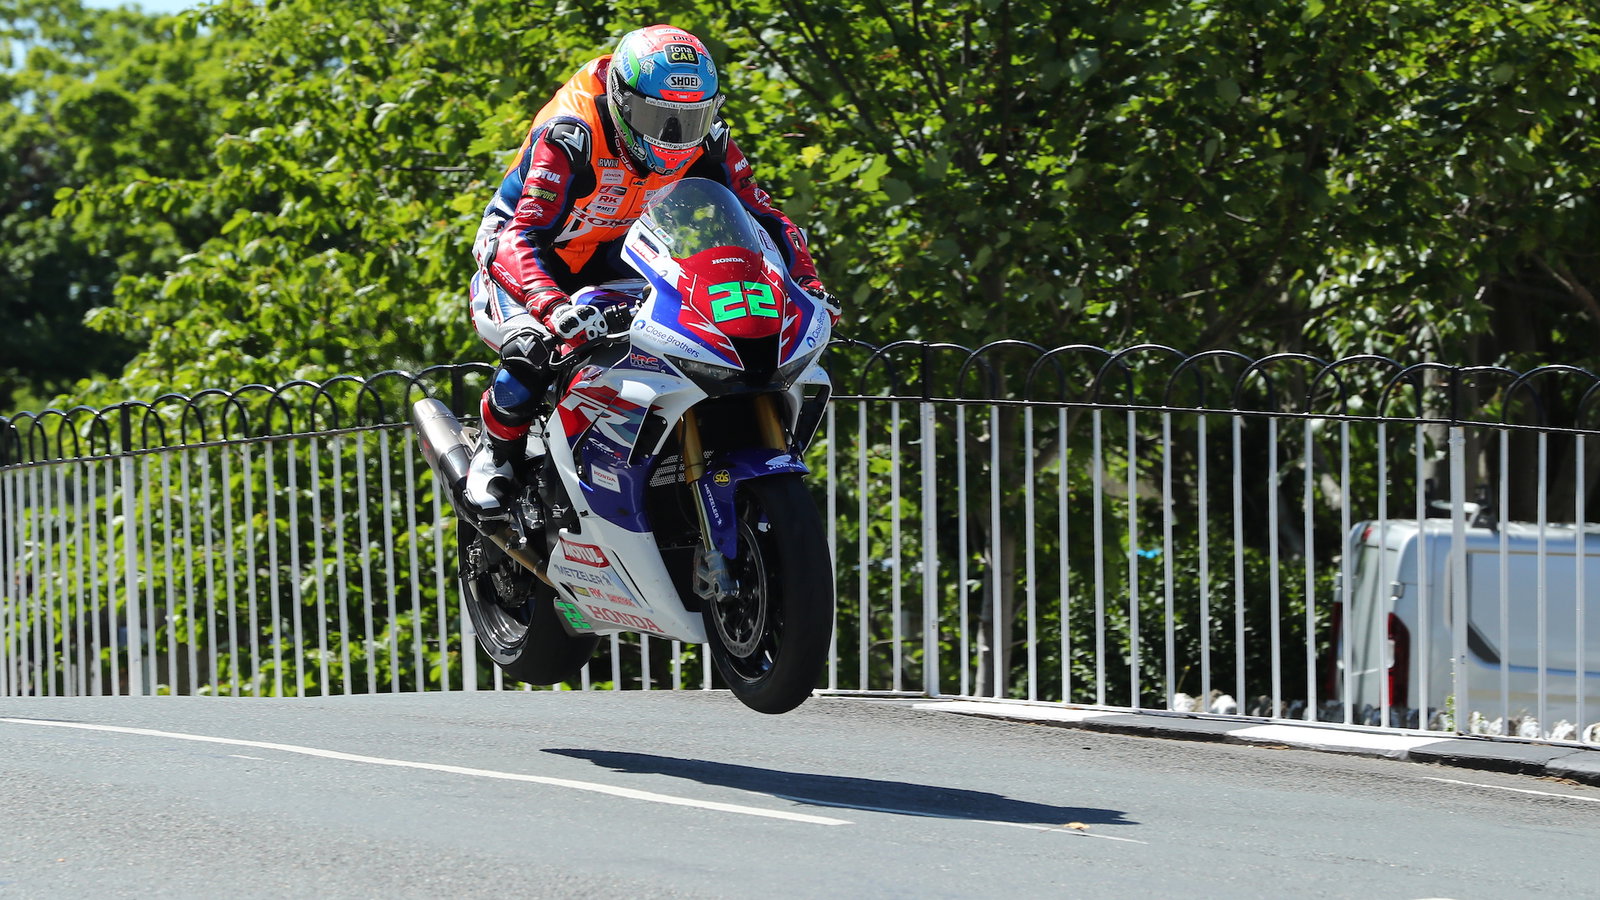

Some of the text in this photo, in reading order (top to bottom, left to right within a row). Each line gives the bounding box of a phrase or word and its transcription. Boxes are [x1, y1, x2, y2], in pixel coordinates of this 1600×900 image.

[671, 52, 695, 61] CAB
[670, 76, 698, 87] SHOEI
[599, 195, 618, 203] RK
[711, 256, 745, 265] HONDA
[707, 280, 780, 324] 22
[645, 325, 700, 359] Close Brothers
[593, 470, 617, 483] HONDA
[585, 603, 665, 633] HONDA
